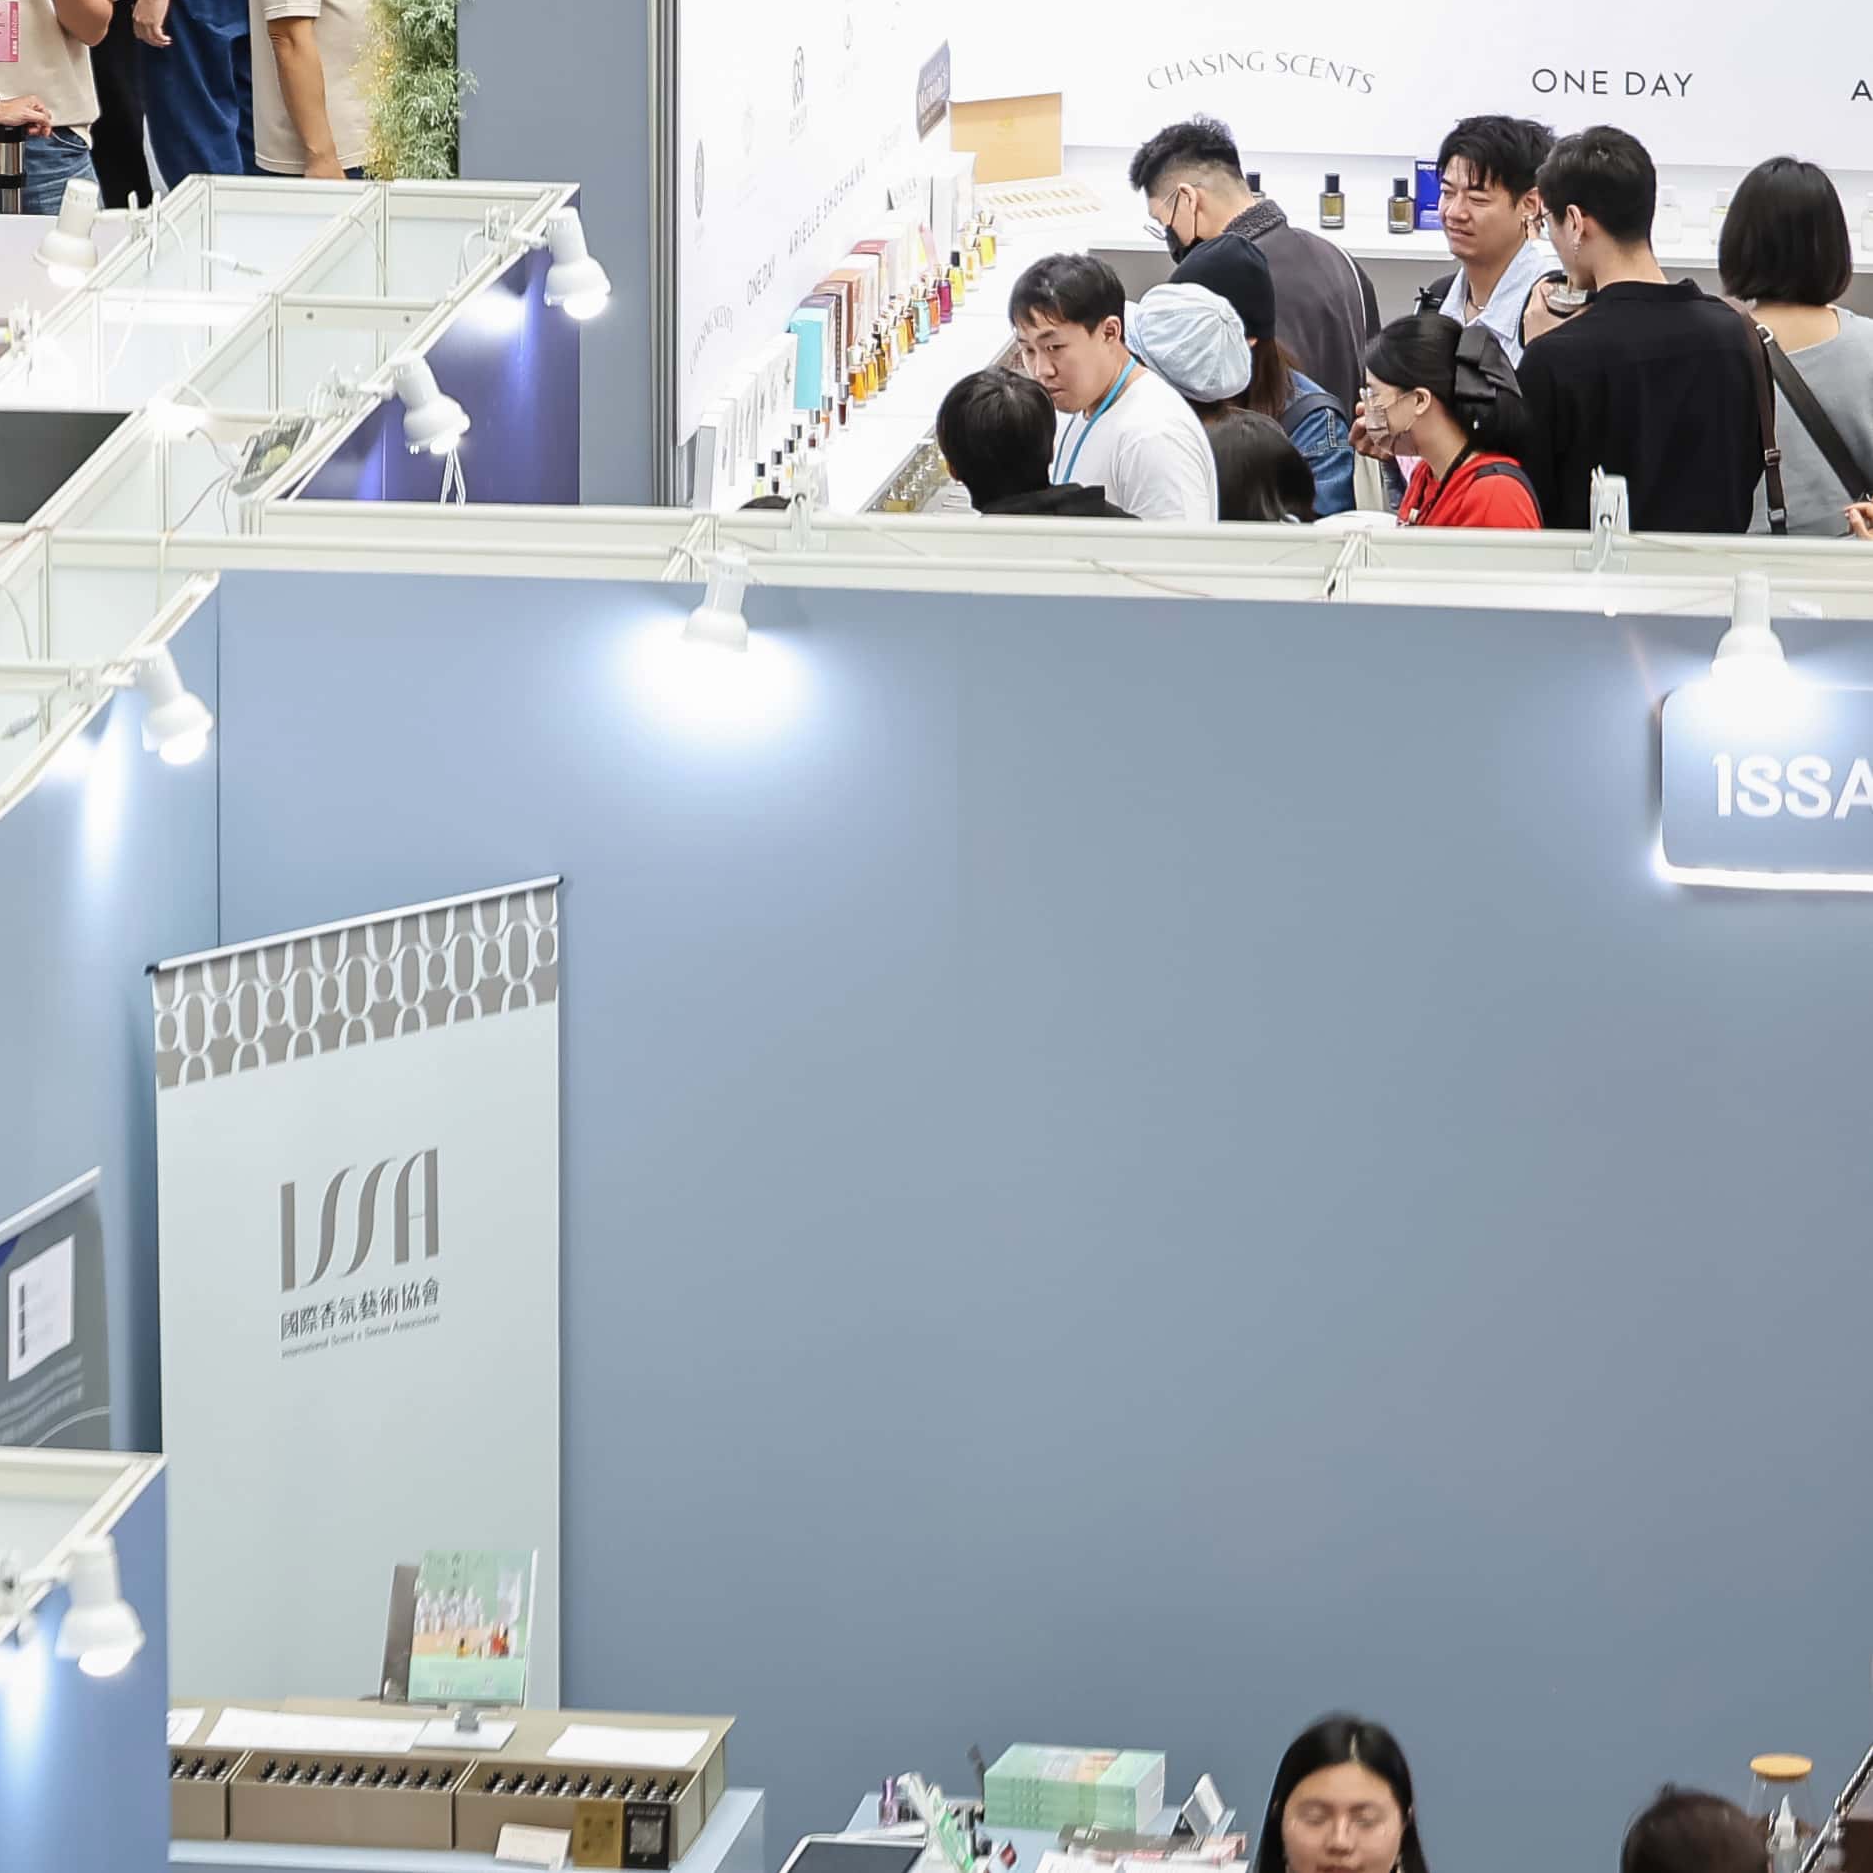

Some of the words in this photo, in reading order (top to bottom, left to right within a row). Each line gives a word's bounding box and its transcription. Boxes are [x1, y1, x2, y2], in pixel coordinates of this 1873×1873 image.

[1146, 49, 1265, 91] CHASING
[1274, 50, 1376, 95] SCENTS
[1531, 67, 1609, 95] ONE
[1623, 71, 1694, 98] DAY
[280, 1276, 440, 1341] 國際香氛藝術協會
